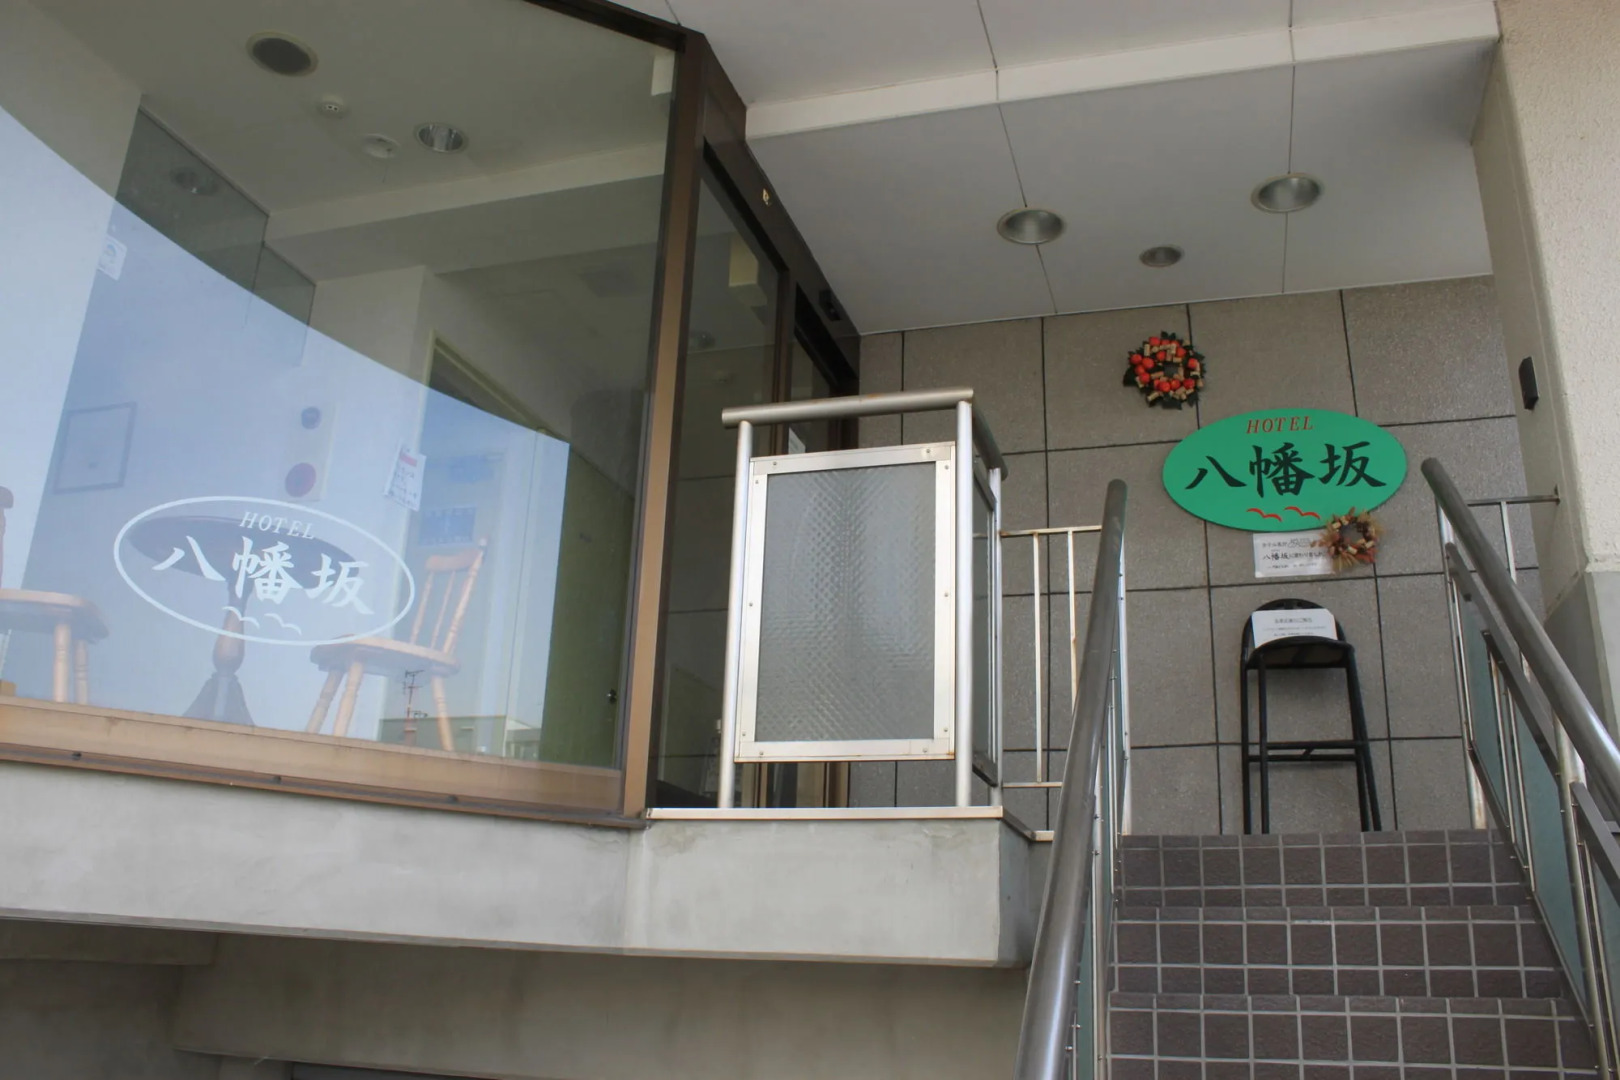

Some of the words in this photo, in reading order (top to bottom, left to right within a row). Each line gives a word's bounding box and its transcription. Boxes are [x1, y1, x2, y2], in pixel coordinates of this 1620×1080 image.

[1246, 416, 1314, 434] HOTEL
[1185, 441, 1387, 498] 八幡坂
[239, 511, 315, 540] HOTEL
[152, 535, 374, 615] 八幡坂
